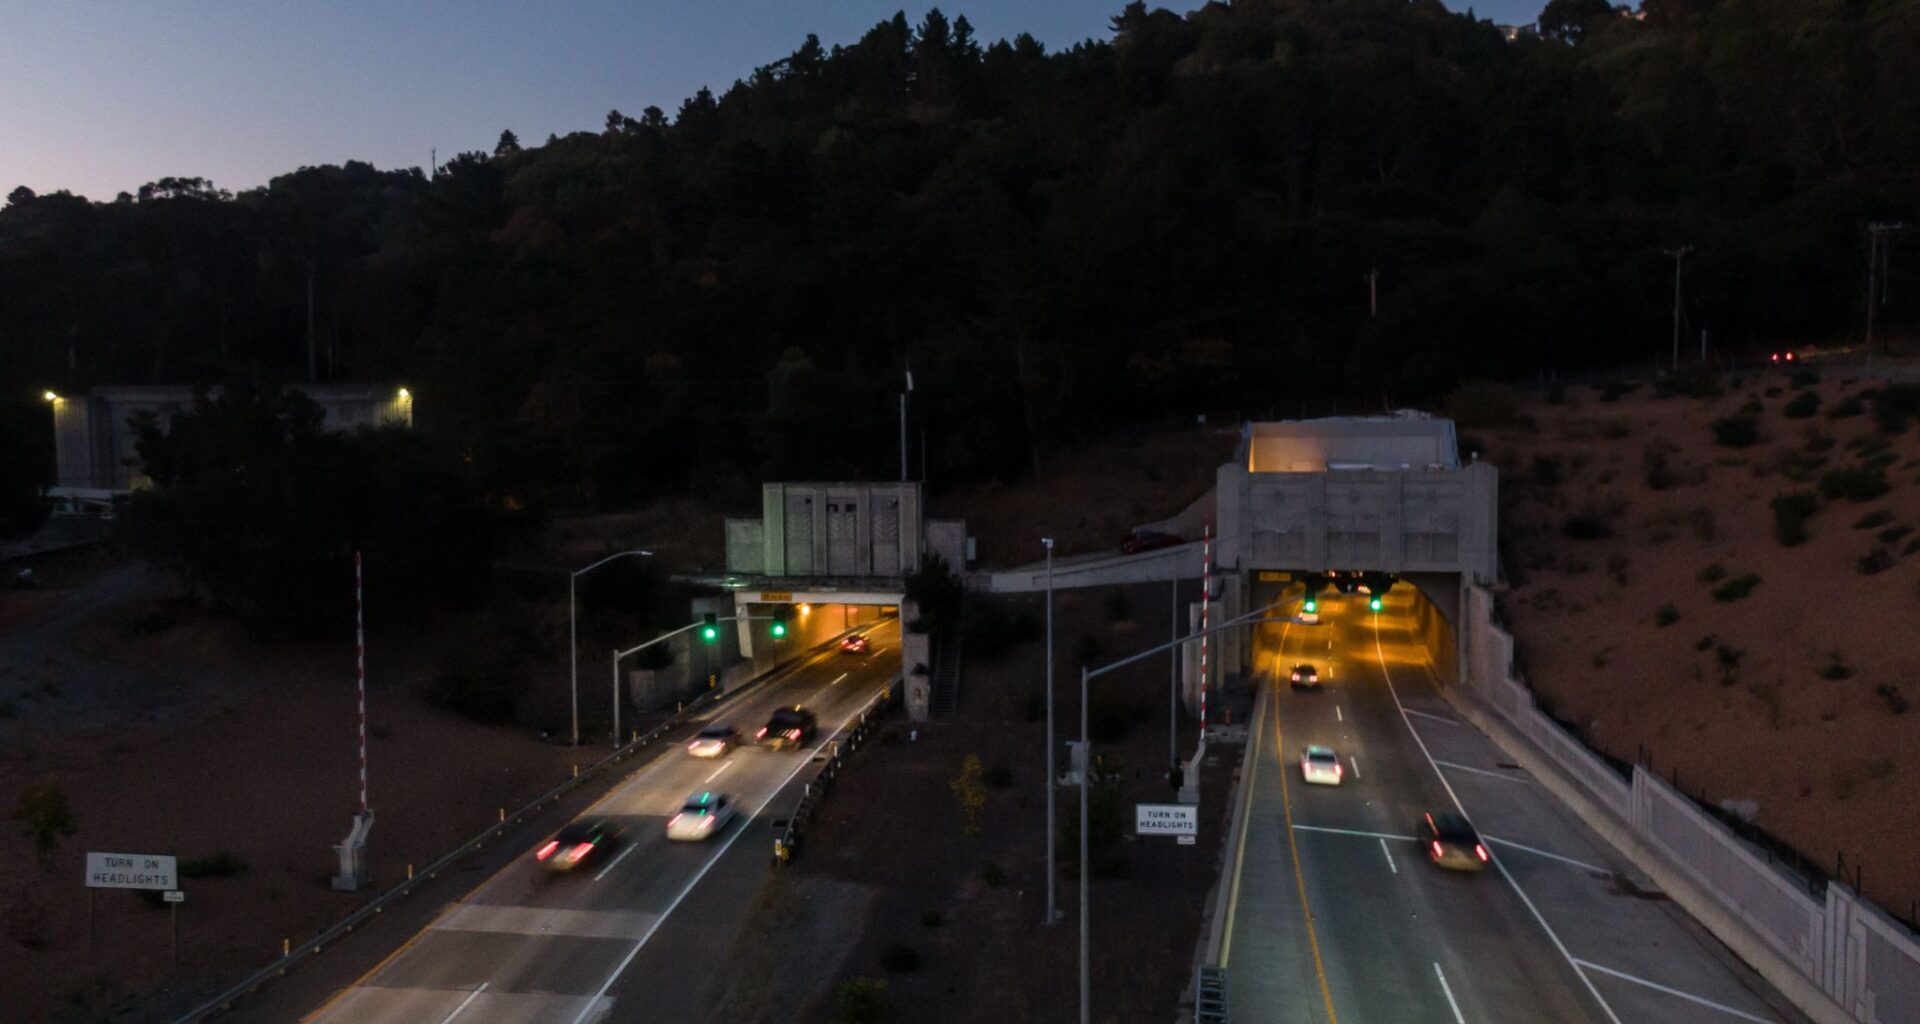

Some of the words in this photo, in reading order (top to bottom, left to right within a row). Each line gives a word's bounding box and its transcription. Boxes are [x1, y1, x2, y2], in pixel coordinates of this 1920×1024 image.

[1174, 811, 1186, 819] ON
[1140, 820, 1193, 829] HEADLIGHTS
[105, 857, 133, 868] TURN
[144, 859, 159, 869] ON
[94, 872, 168, 885] HEADLIGHTS
